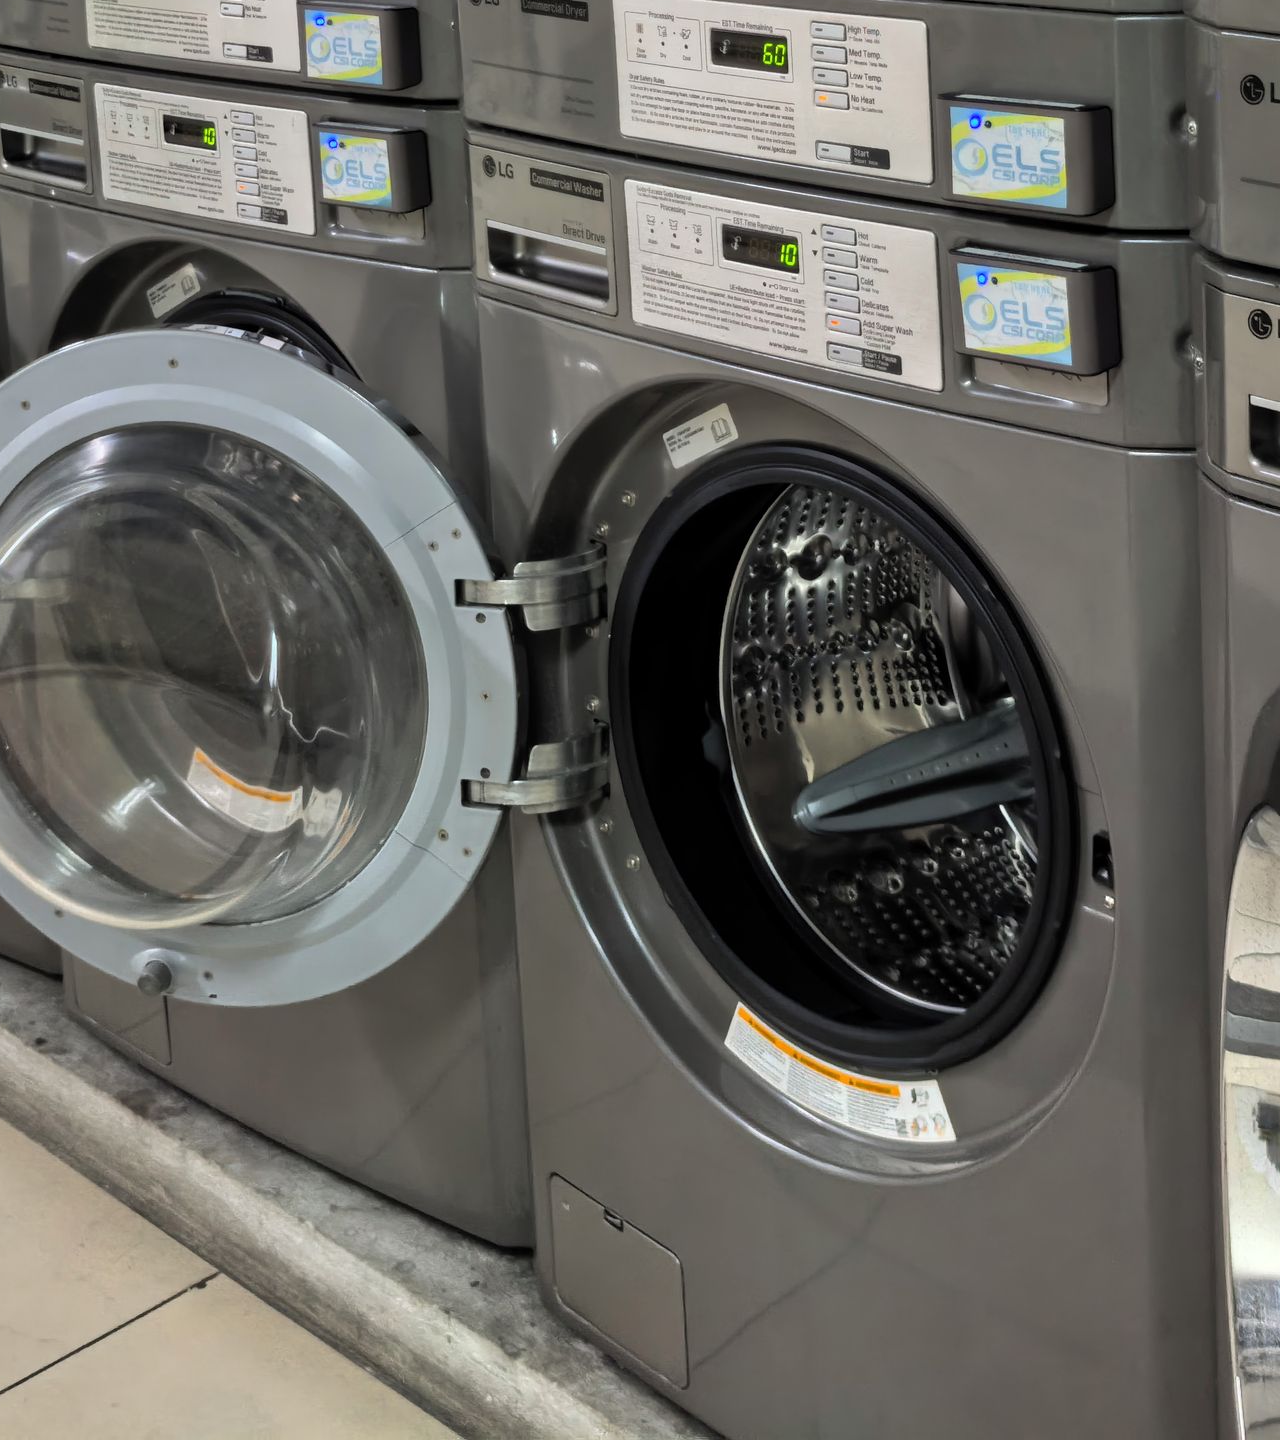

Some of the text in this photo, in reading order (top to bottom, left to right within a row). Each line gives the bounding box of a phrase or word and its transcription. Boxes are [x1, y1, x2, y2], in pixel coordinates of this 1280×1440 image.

[566, 4, 586, 17] Dryer
[848, 26, 882, 37] High Temp.
[333, 37, 377, 58] ELS
[762, 43, 785, 66] 60
[848, 48, 882, 60] Med Temp.
[6, 74, 17, 87] LG
[850, 73, 882, 83] Low Temp.
[851, 95, 875, 105] No Heat
[204, 128, 216, 145] 10
[854, 148, 870, 158] Start
[992, 143, 1060, 174] ELS
[346, 160, 386, 181] ELS
[498, 162, 514, 178] LG
[992, 169, 1061, 186] CSI CORP
[532, 172, 602, 198] Commercial Washer
[562, 224, 606, 244] Direct Drive
[858, 232, 868, 240] Hot
[780, 244, 797, 266] 10
[859, 255, 878, 264] Warm
[860, 278, 874, 286] Cold
[862, 300, 890, 312] Delicates
[1000, 300, 1065, 330] ELS
[863, 320, 914, 336] Add Super Wash
[1002, 324, 1022, 337] CSI
